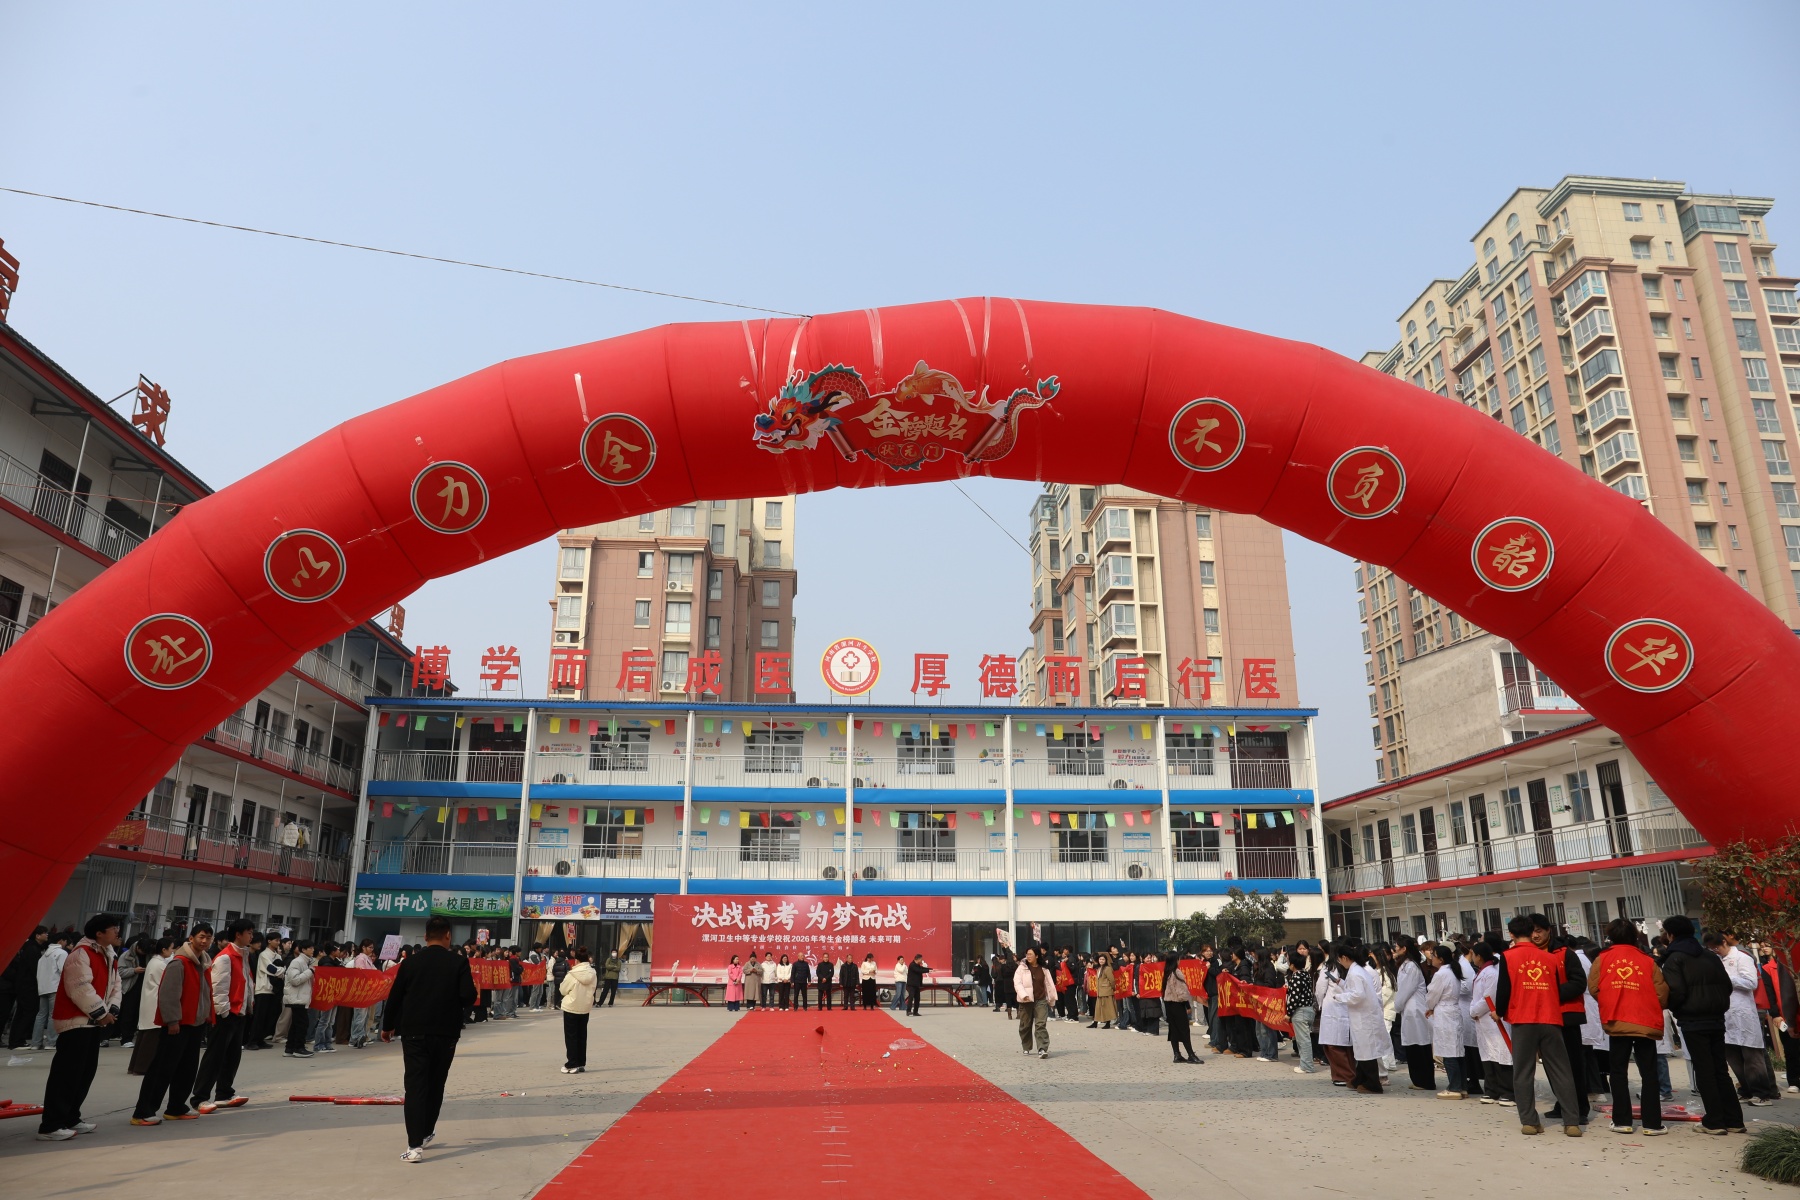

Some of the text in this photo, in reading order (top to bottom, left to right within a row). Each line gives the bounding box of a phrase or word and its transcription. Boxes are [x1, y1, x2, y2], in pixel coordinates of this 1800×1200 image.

[132, 382, 171, 447] 求
[849, 397, 968, 441] 金榜题名
[879, 442, 940, 457] 状元门
[410, 645, 792, 695] 博学而后成医
[910, 653, 1281, 701] 厚德而后行医
[358, 893, 428, 912] 实训中心
[446, 897, 500, 911] 校园超市
[691, 901, 912, 931] 决战高考 为梦而战
[868, 934, 902, 944] 未来可期
